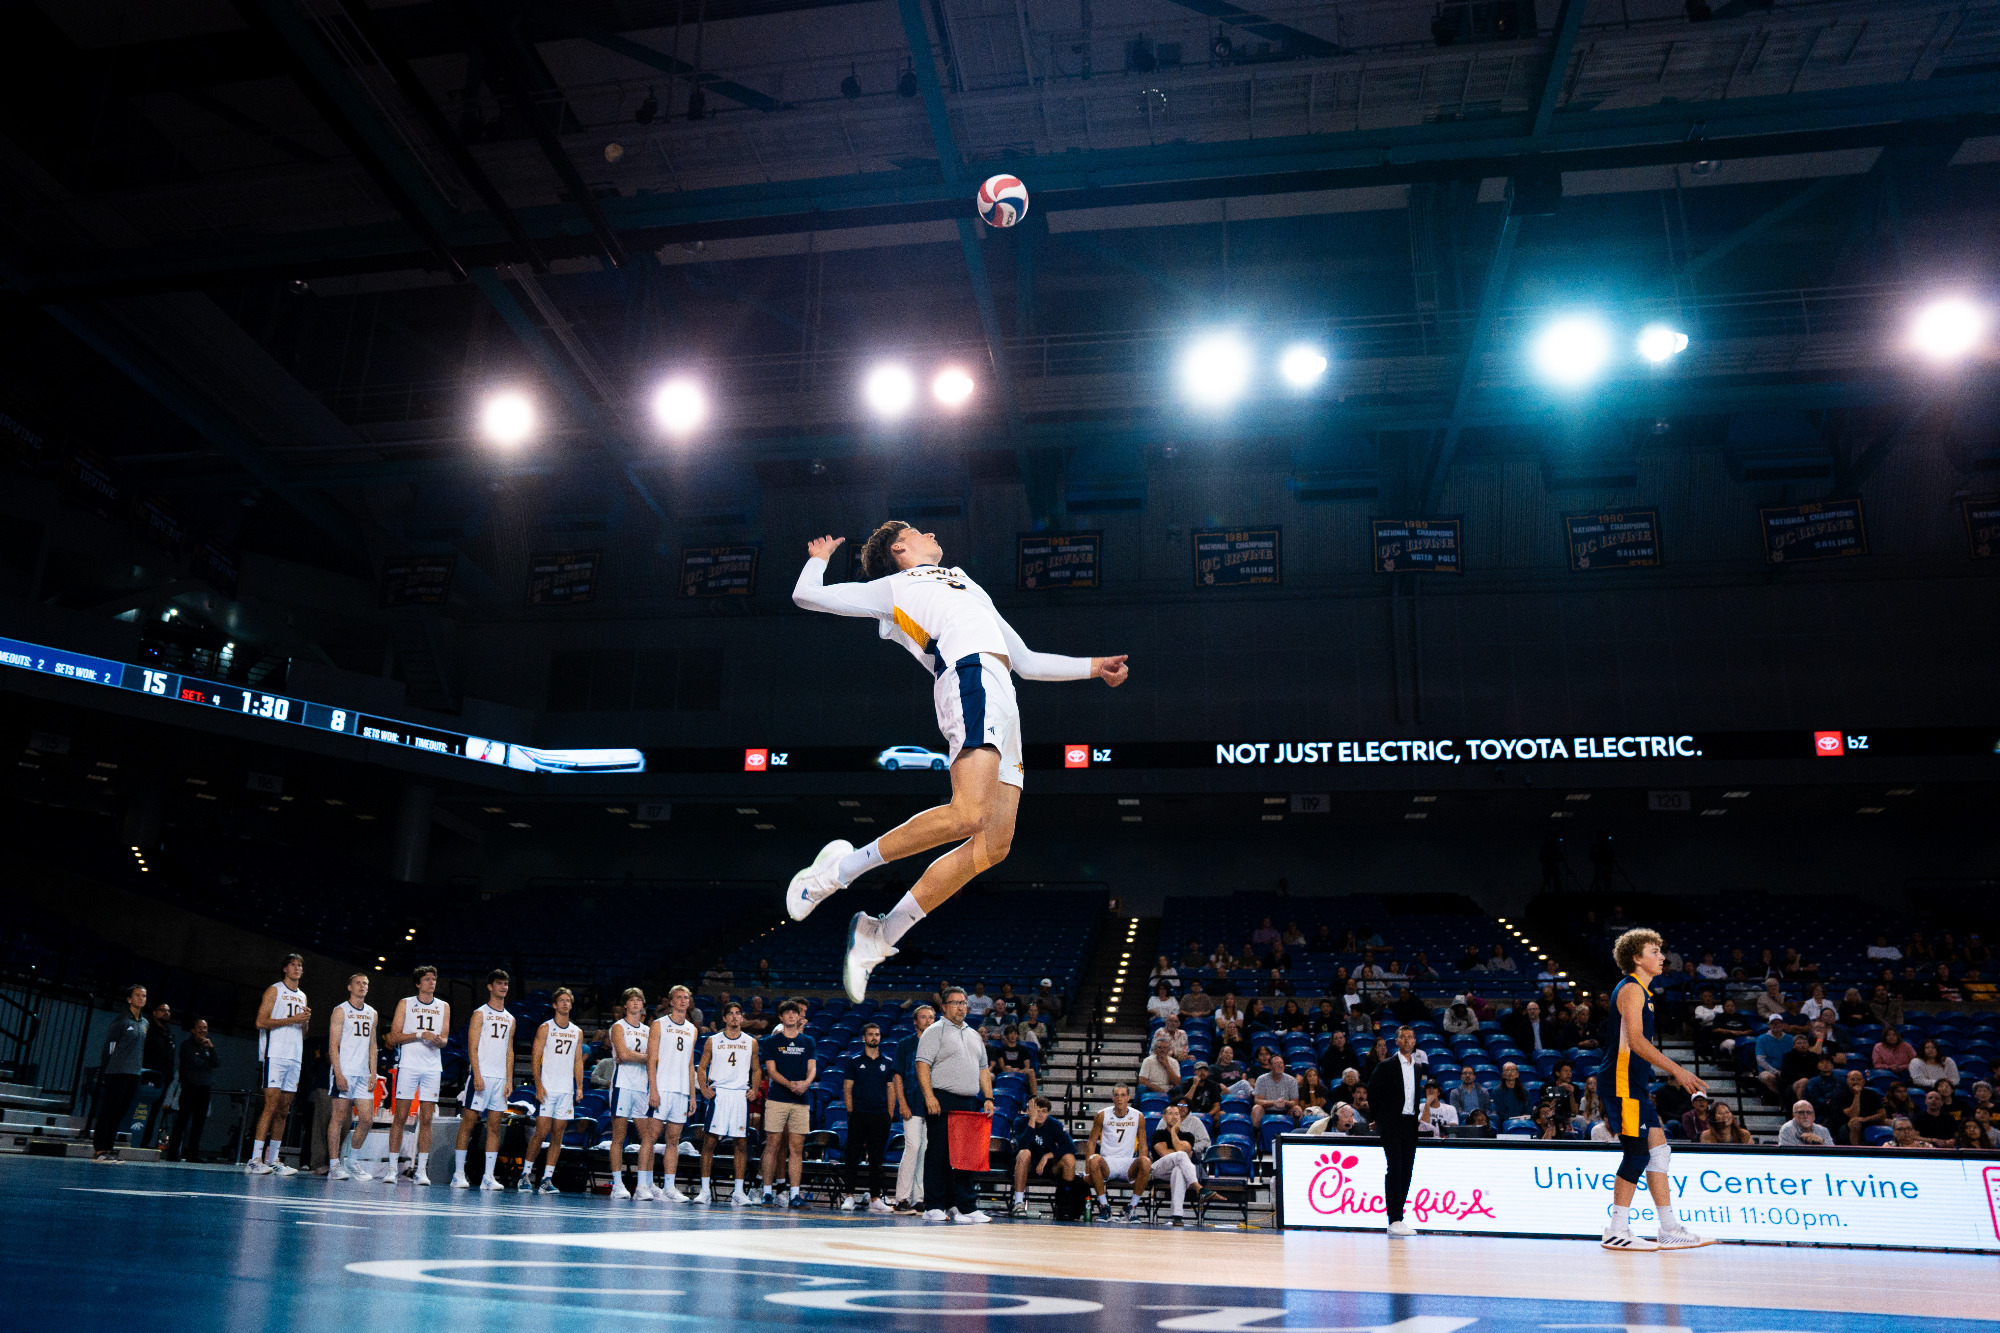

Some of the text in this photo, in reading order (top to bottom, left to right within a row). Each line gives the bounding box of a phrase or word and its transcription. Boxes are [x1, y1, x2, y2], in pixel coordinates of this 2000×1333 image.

[1773, 531, 1797, 549] UC
[1379, 542, 1401, 559] UC
[1575, 540, 1597, 557] UC
[1025, 560, 1043, 576] UC
[1200, 556, 1221, 572] UC
[38, 659, 45, 670] 2
[55, 663, 111, 683] SETS WON: 2
[143, 669, 167, 695] 15
[182, 688, 221, 706] SET: 4
[242, 691, 289, 721] 1:30
[330, 709, 347, 732] 8
[363, 726, 380, 740] SETS
[415, 736, 448, 753] TIMEOUTS:
[1216, 736, 1703, 764] NOT JUST ELECTRIC, TOYOTA ELECTRIC.
[1847, 735, 1869, 749] bZ
[770, 752, 789, 765] bZ
[1093, 748, 1111, 762] bZ
[354, 1021, 370, 1037] 16
[416, 1015, 435, 1031] 11
[491, 1023, 508, 1039] 17
[555, 1039, 573, 1055] 27
[635, 1038, 641, 1053] 2
[677, 1037, 684, 1051] 8
[728, 1052, 737, 1067] 4
[1116, 1129, 1125, 1143] 7
[1699, 1170, 1812, 1196] Center
[1825, 1172, 1919, 1199] Irvine
[1308, 1166, 1496, 1223] Chic-fil-A
[1679, 1205, 1731, 1223] until
[1739, 1206, 1848, 1231] 11:00pm.
